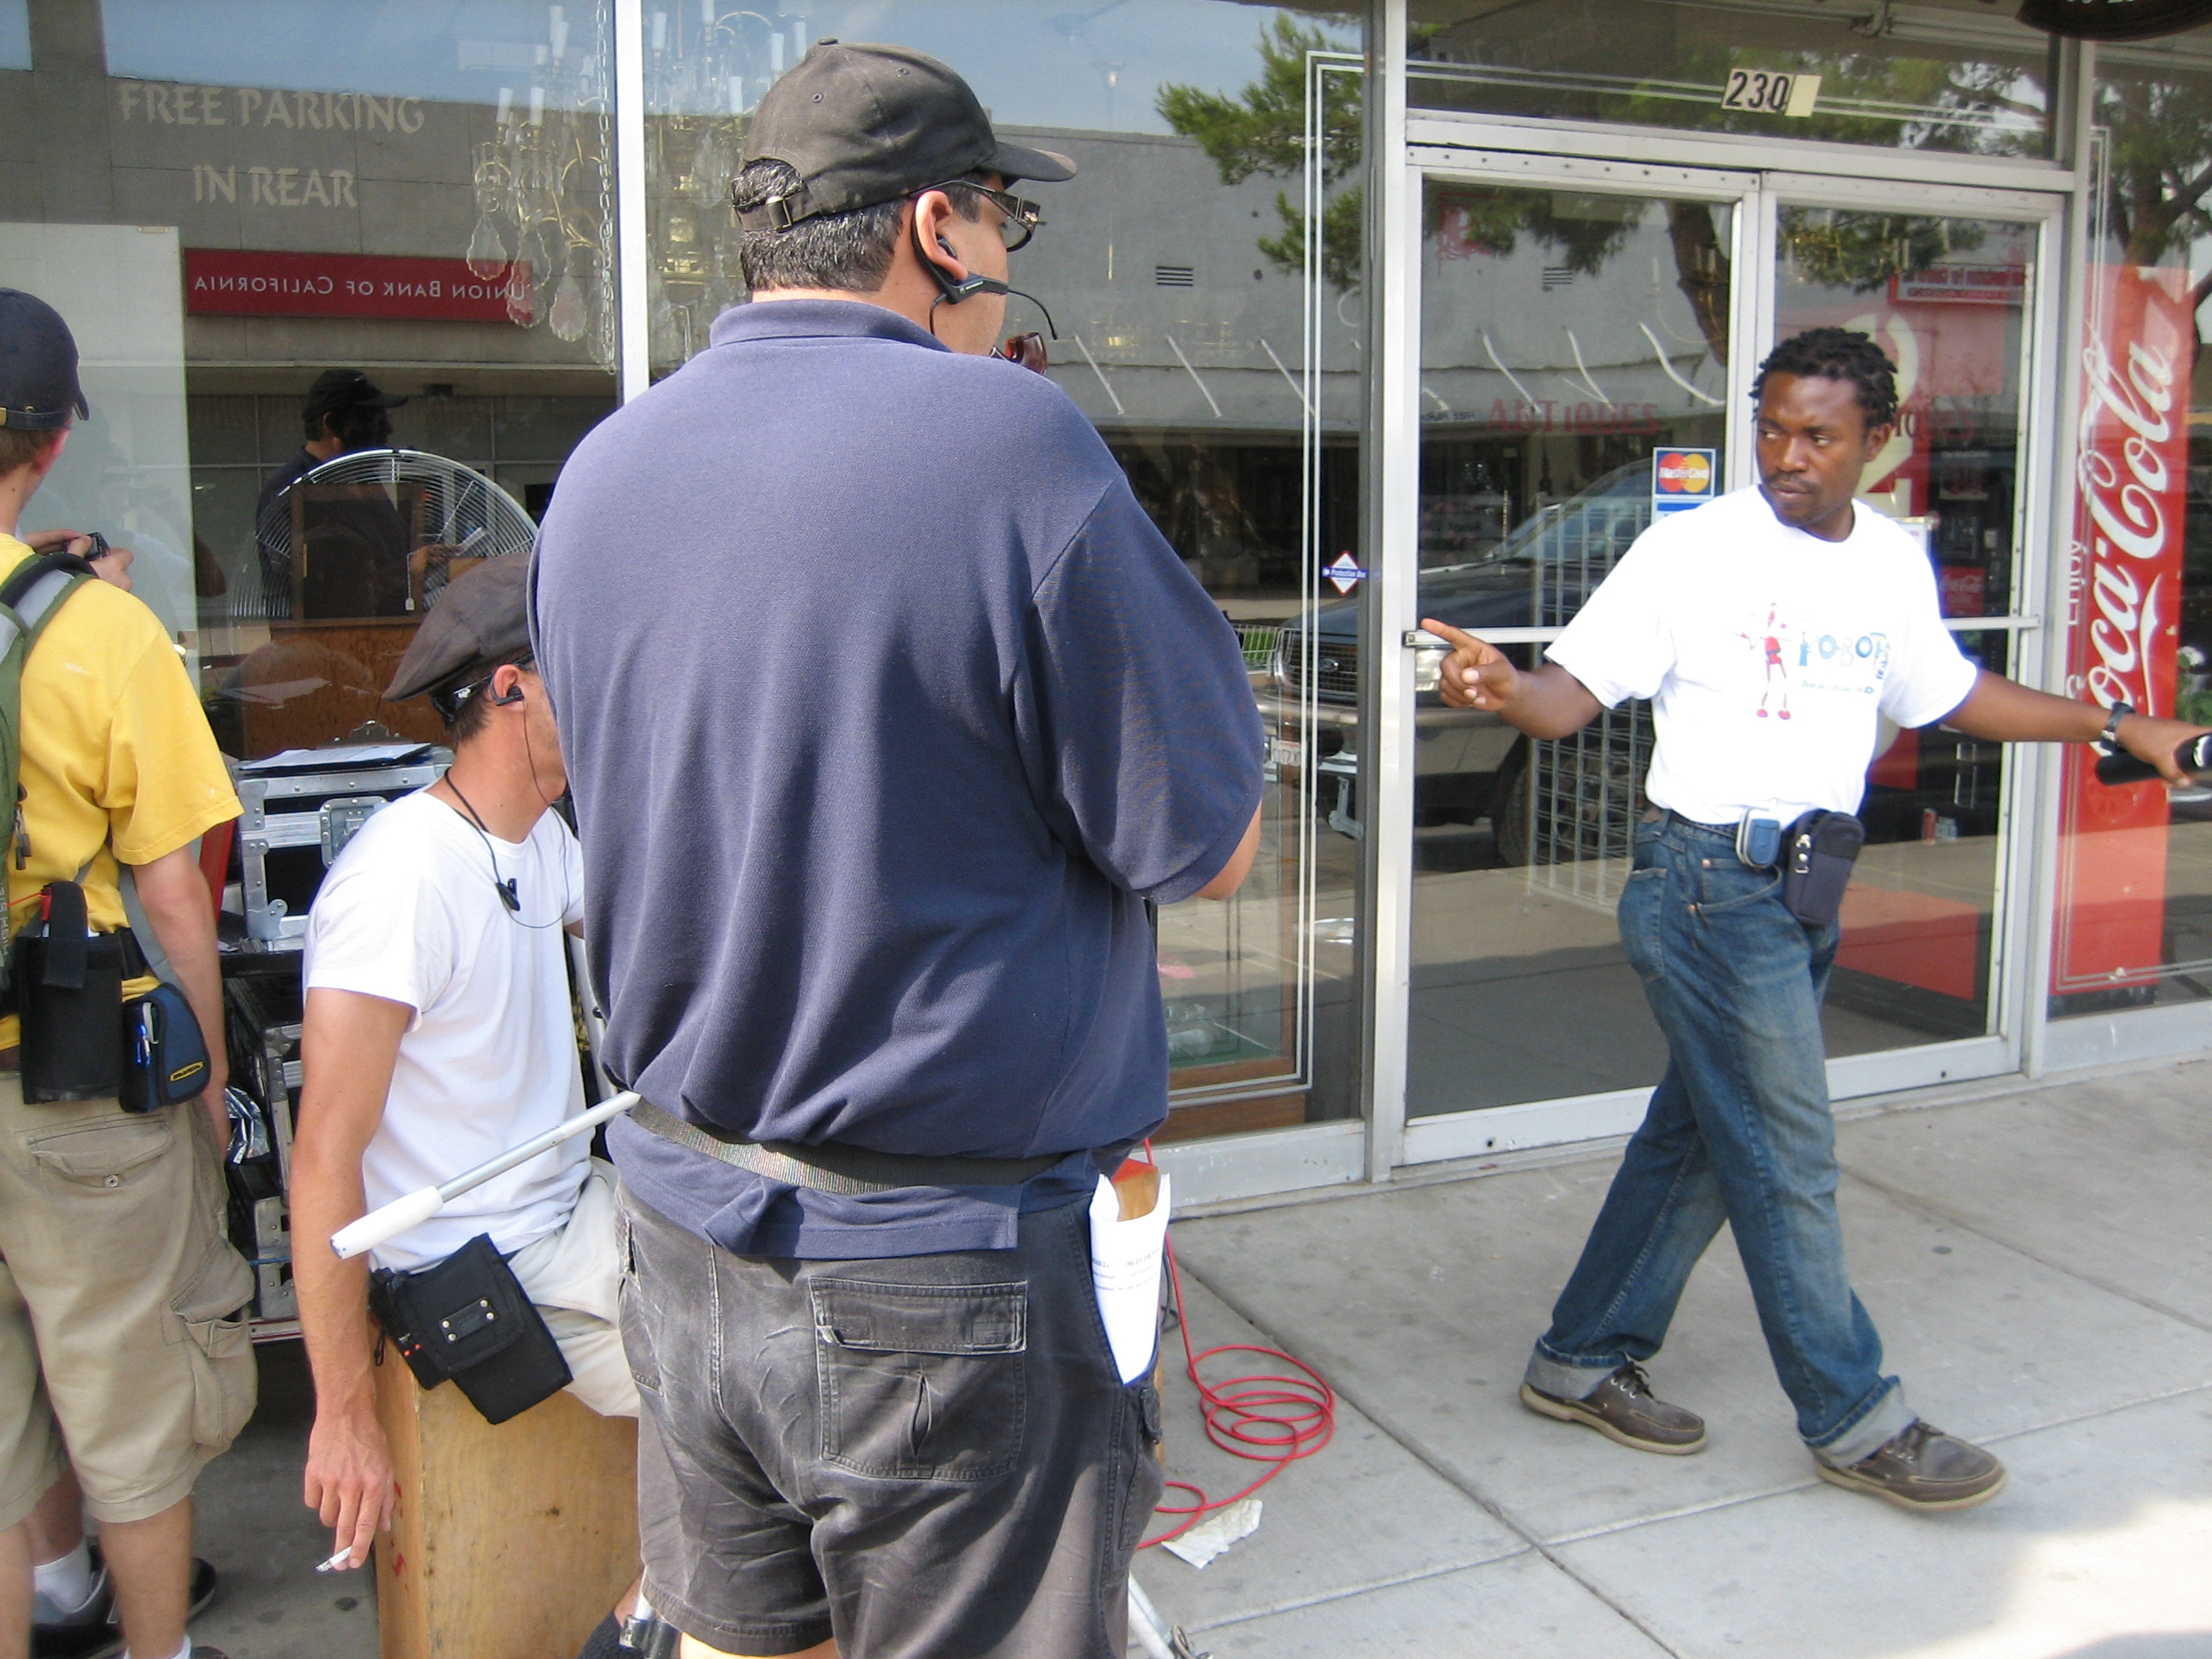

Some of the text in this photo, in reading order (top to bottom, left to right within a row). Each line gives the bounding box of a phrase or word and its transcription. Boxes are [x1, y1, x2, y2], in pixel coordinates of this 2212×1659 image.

[118, 83, 425, 133] FREE PARKING
[1725, 72, 1790, 111] 230
[192, 164, 358, 208] IN REAR
[1487, 398, 1661, 435] ANTIQUES
